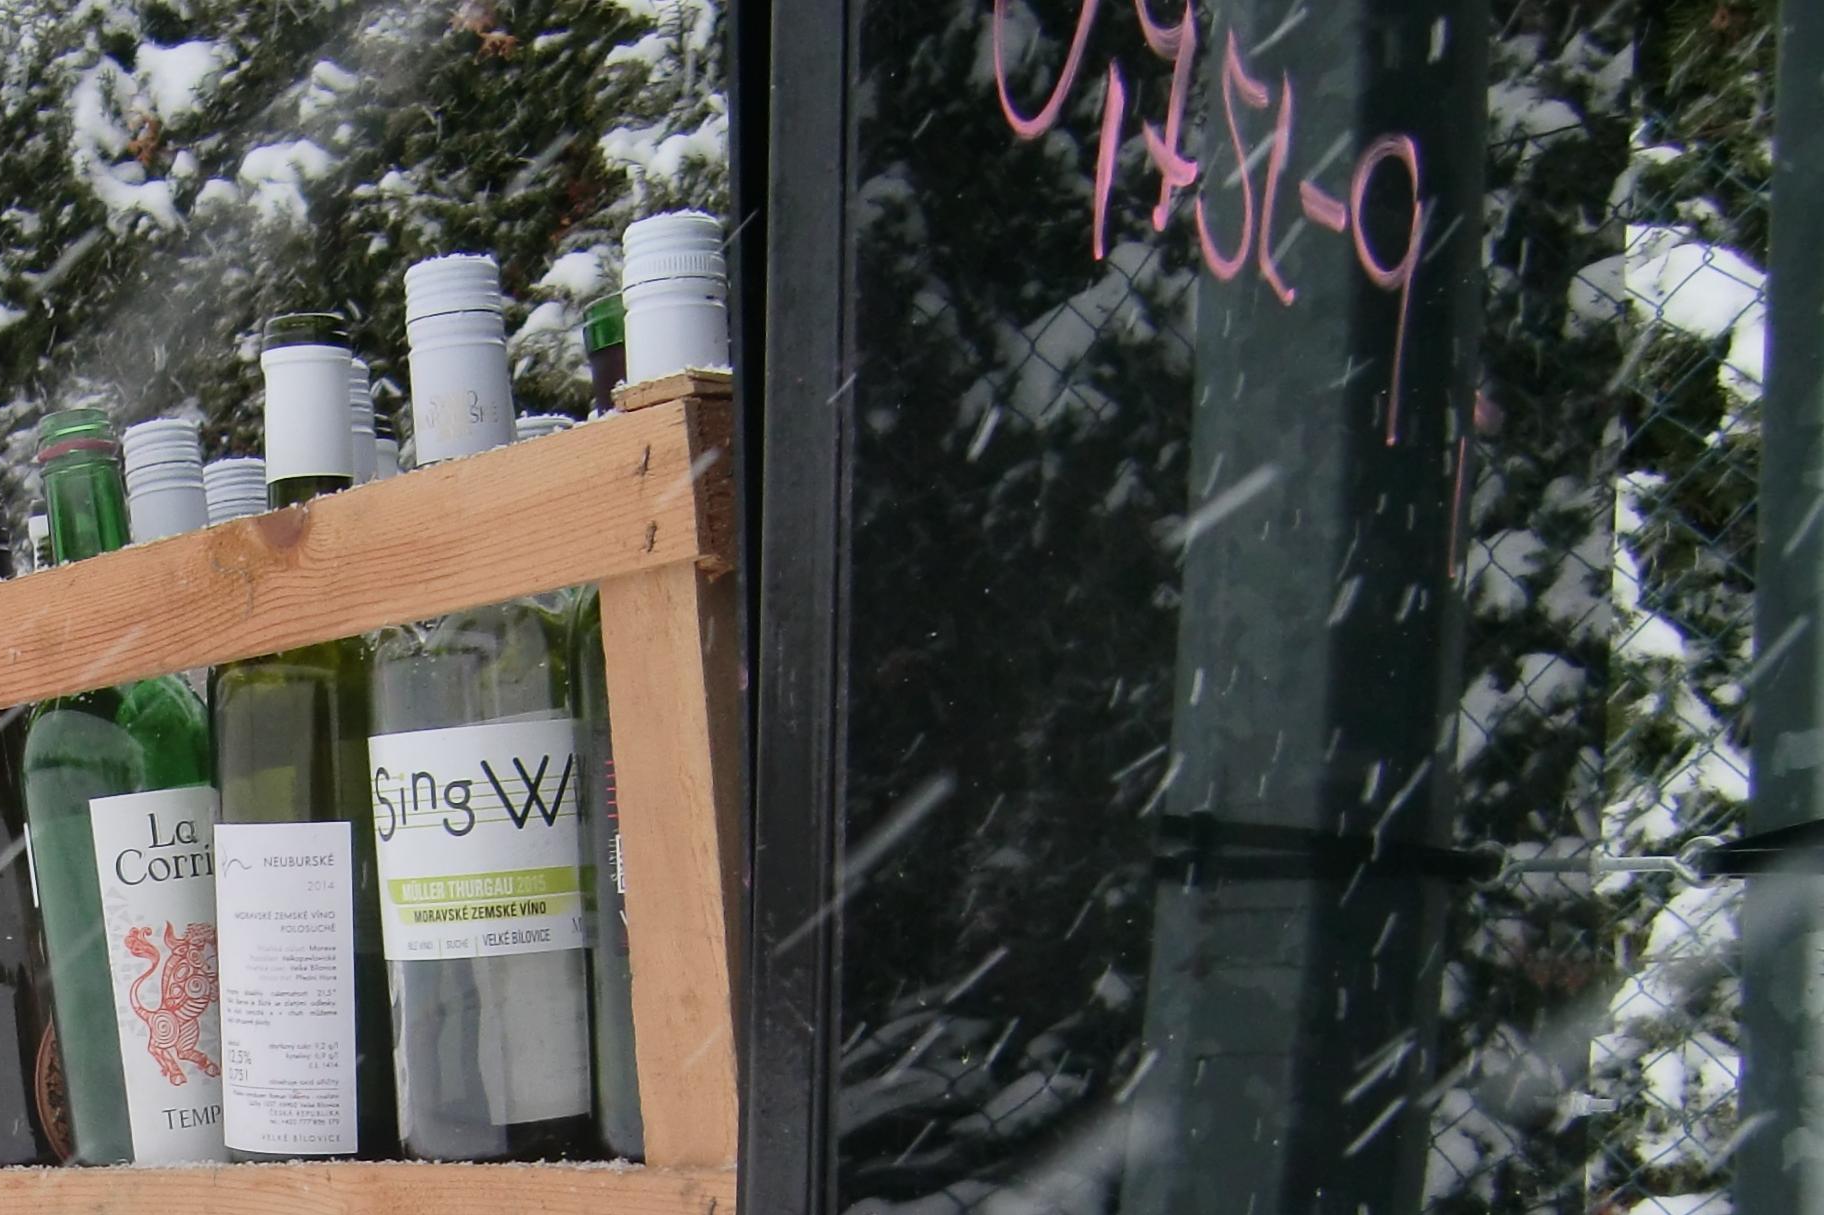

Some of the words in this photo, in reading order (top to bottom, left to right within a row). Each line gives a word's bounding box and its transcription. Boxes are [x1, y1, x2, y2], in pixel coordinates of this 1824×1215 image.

[147, 812, 199, 849] La
[263, 854, 336, 868] NEUBURSKÉ
[401, 879, 445, 902] MÜLLER
[448, 875, 514, 899] THURGAU
[413, 903, 469, 924] MORAVSKÉ
[471, 899, 518, 920] ZEMSKÉ
[520, 898, 548, 916] VÍNO
[482, 929, 510, 947] VELKÉ
[512, 926, 551, 945] BÍLOVICE
[161, 1104, 222, 1131] TEMP
